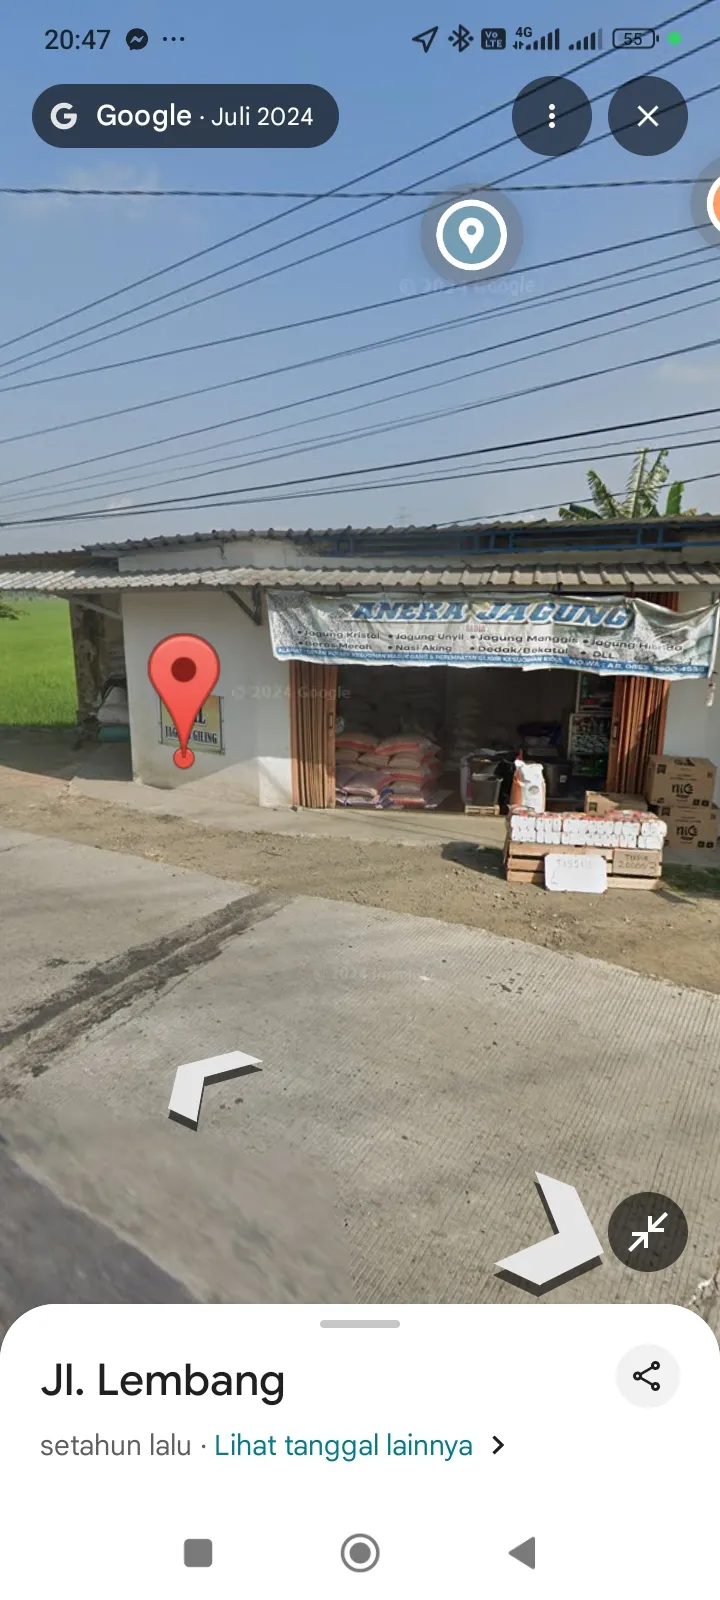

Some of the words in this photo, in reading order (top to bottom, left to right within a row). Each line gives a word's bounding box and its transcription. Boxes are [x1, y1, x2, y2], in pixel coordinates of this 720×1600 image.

[351, 602, 466, 620] ANEKA
[476, 602, 629, 625] JAGUNG
[303, 629, 343, 639] Jagung
[346, 631, 380, 639] Kristal
[394, 633, 434, 642] Jagung
[437, 632, 464, 641] Unyil
[477, 634, 523, 643] Jagung
[526, 635, 578, 645] Manggis
[422, 644, 452, 652] Aking
[591, 638, 636, 650] Jagung
[193, 730, 218, 745] GILING
